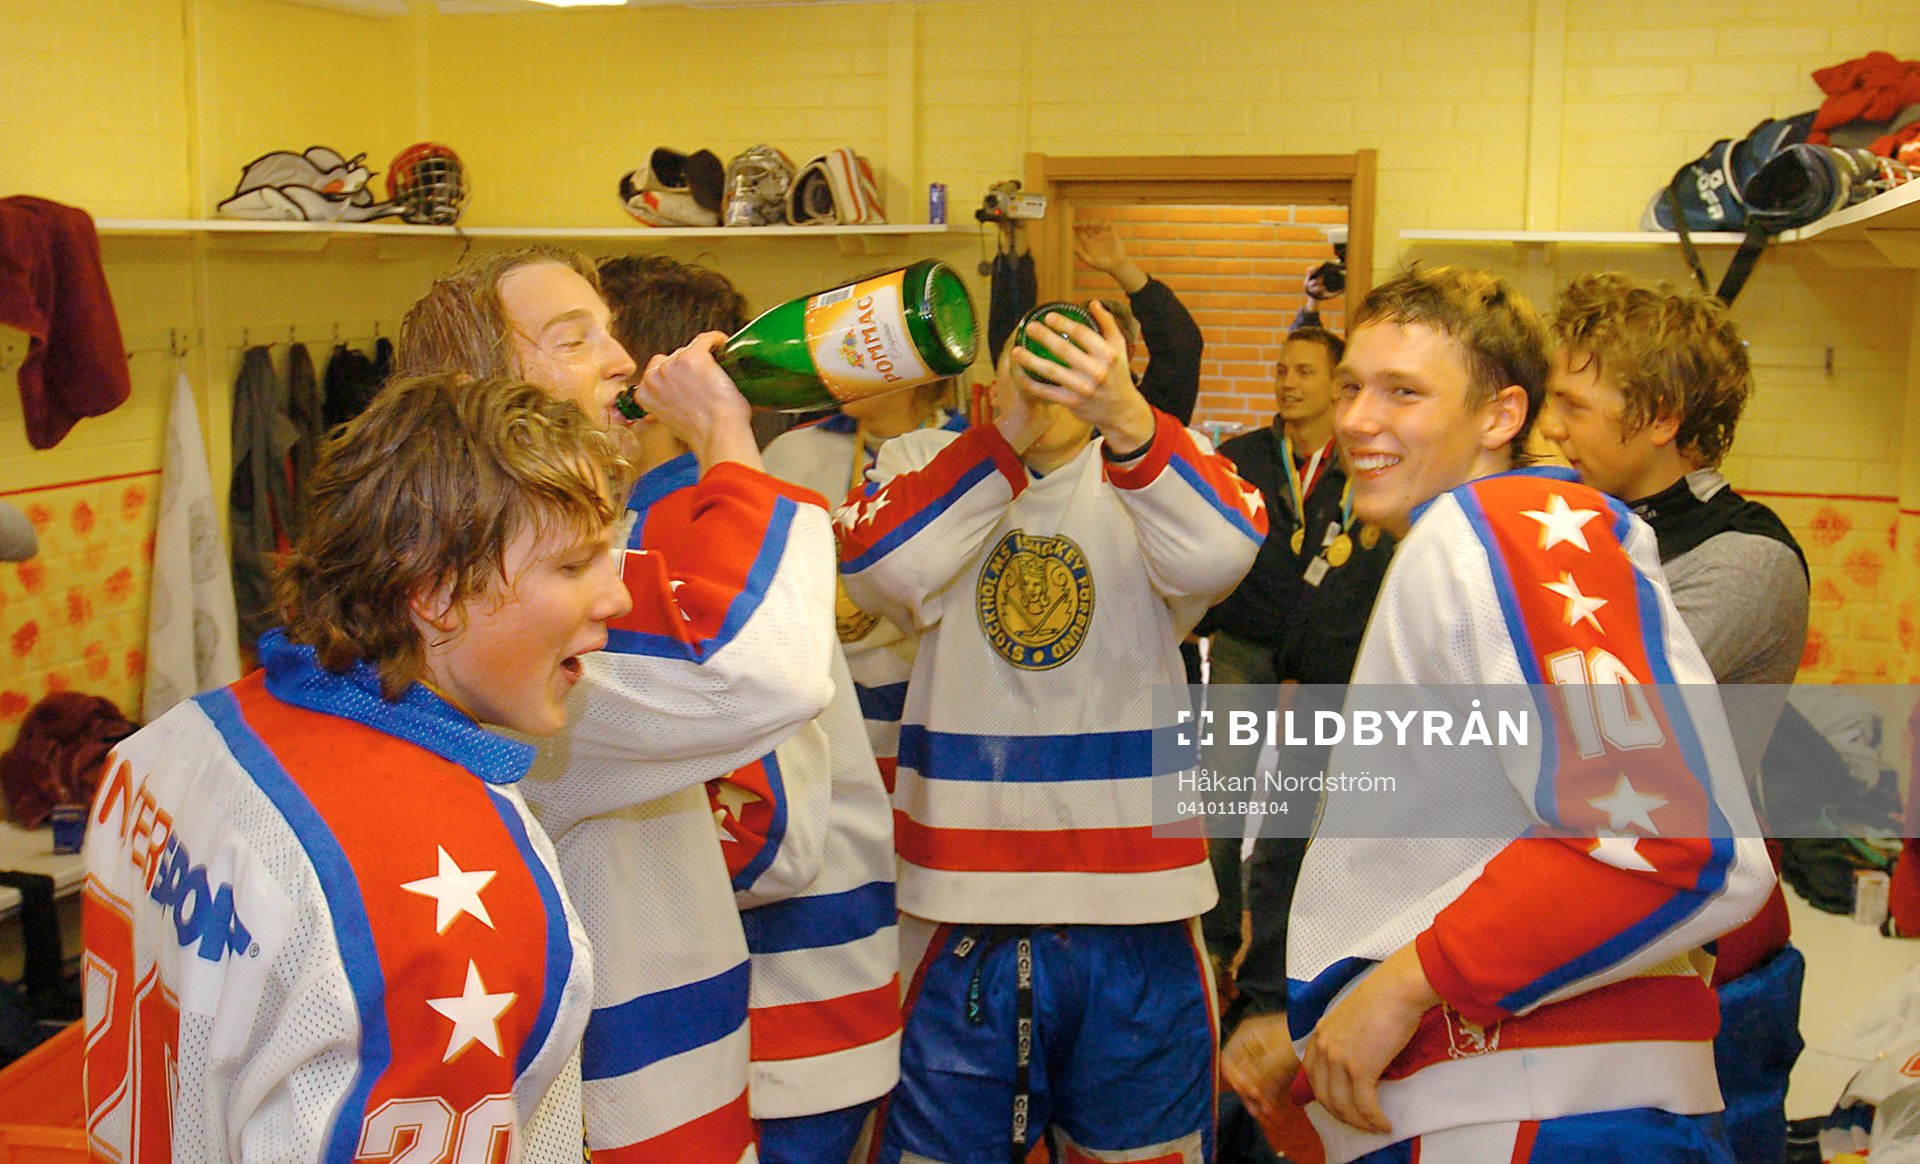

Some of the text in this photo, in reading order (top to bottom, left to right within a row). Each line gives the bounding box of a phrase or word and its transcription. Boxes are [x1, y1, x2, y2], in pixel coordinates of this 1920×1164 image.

[857, 295, 903, 383] POMMAC
[981, 544, 1025, 662] STOCKHOLMS
[1015, 534, 1085, 570] ICKEY
[1547, 648, 1666, 760] 10
[1018, 939, 1032, 989] CCM
[1018, 1018, 1032, 1066] CCM
[1012, 1095, 1028, 1143] CCM
